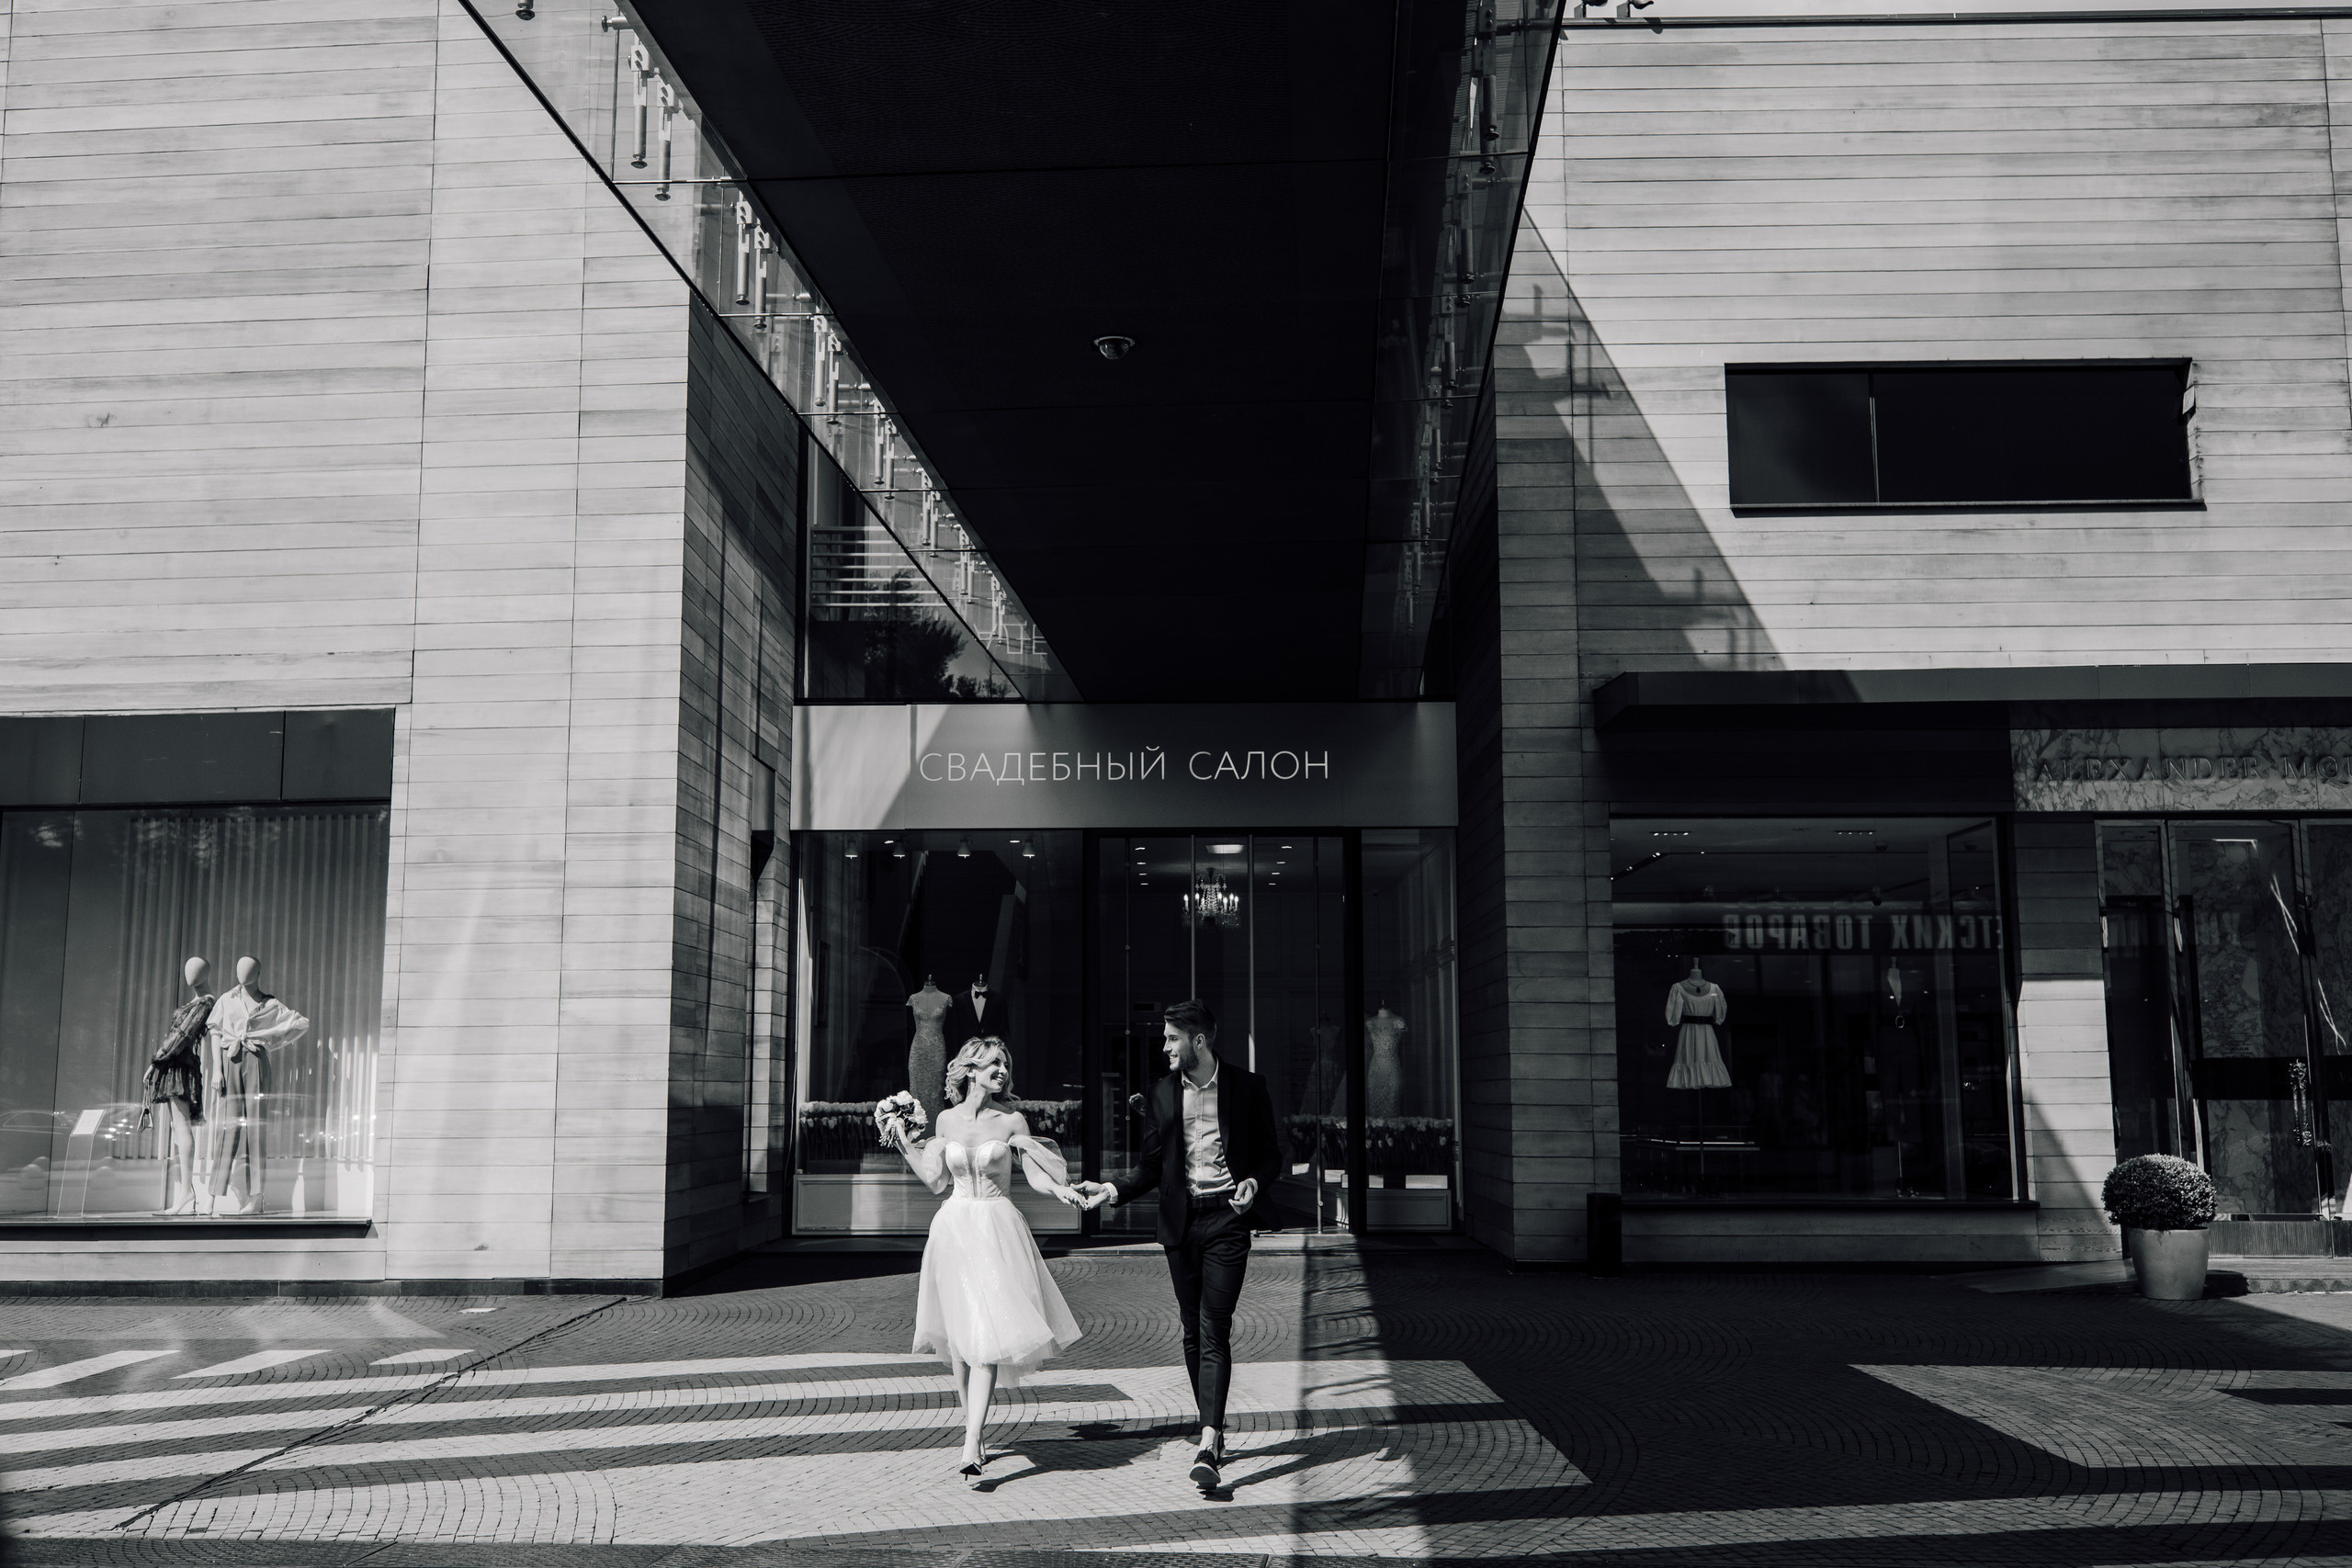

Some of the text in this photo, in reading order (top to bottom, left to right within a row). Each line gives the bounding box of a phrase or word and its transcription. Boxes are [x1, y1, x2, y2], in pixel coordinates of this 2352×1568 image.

[919, 745, 1329, 786] СВАДЕБНЫЙ САЛОН
[2036, 755, 2263, 782] ALEXANDER
